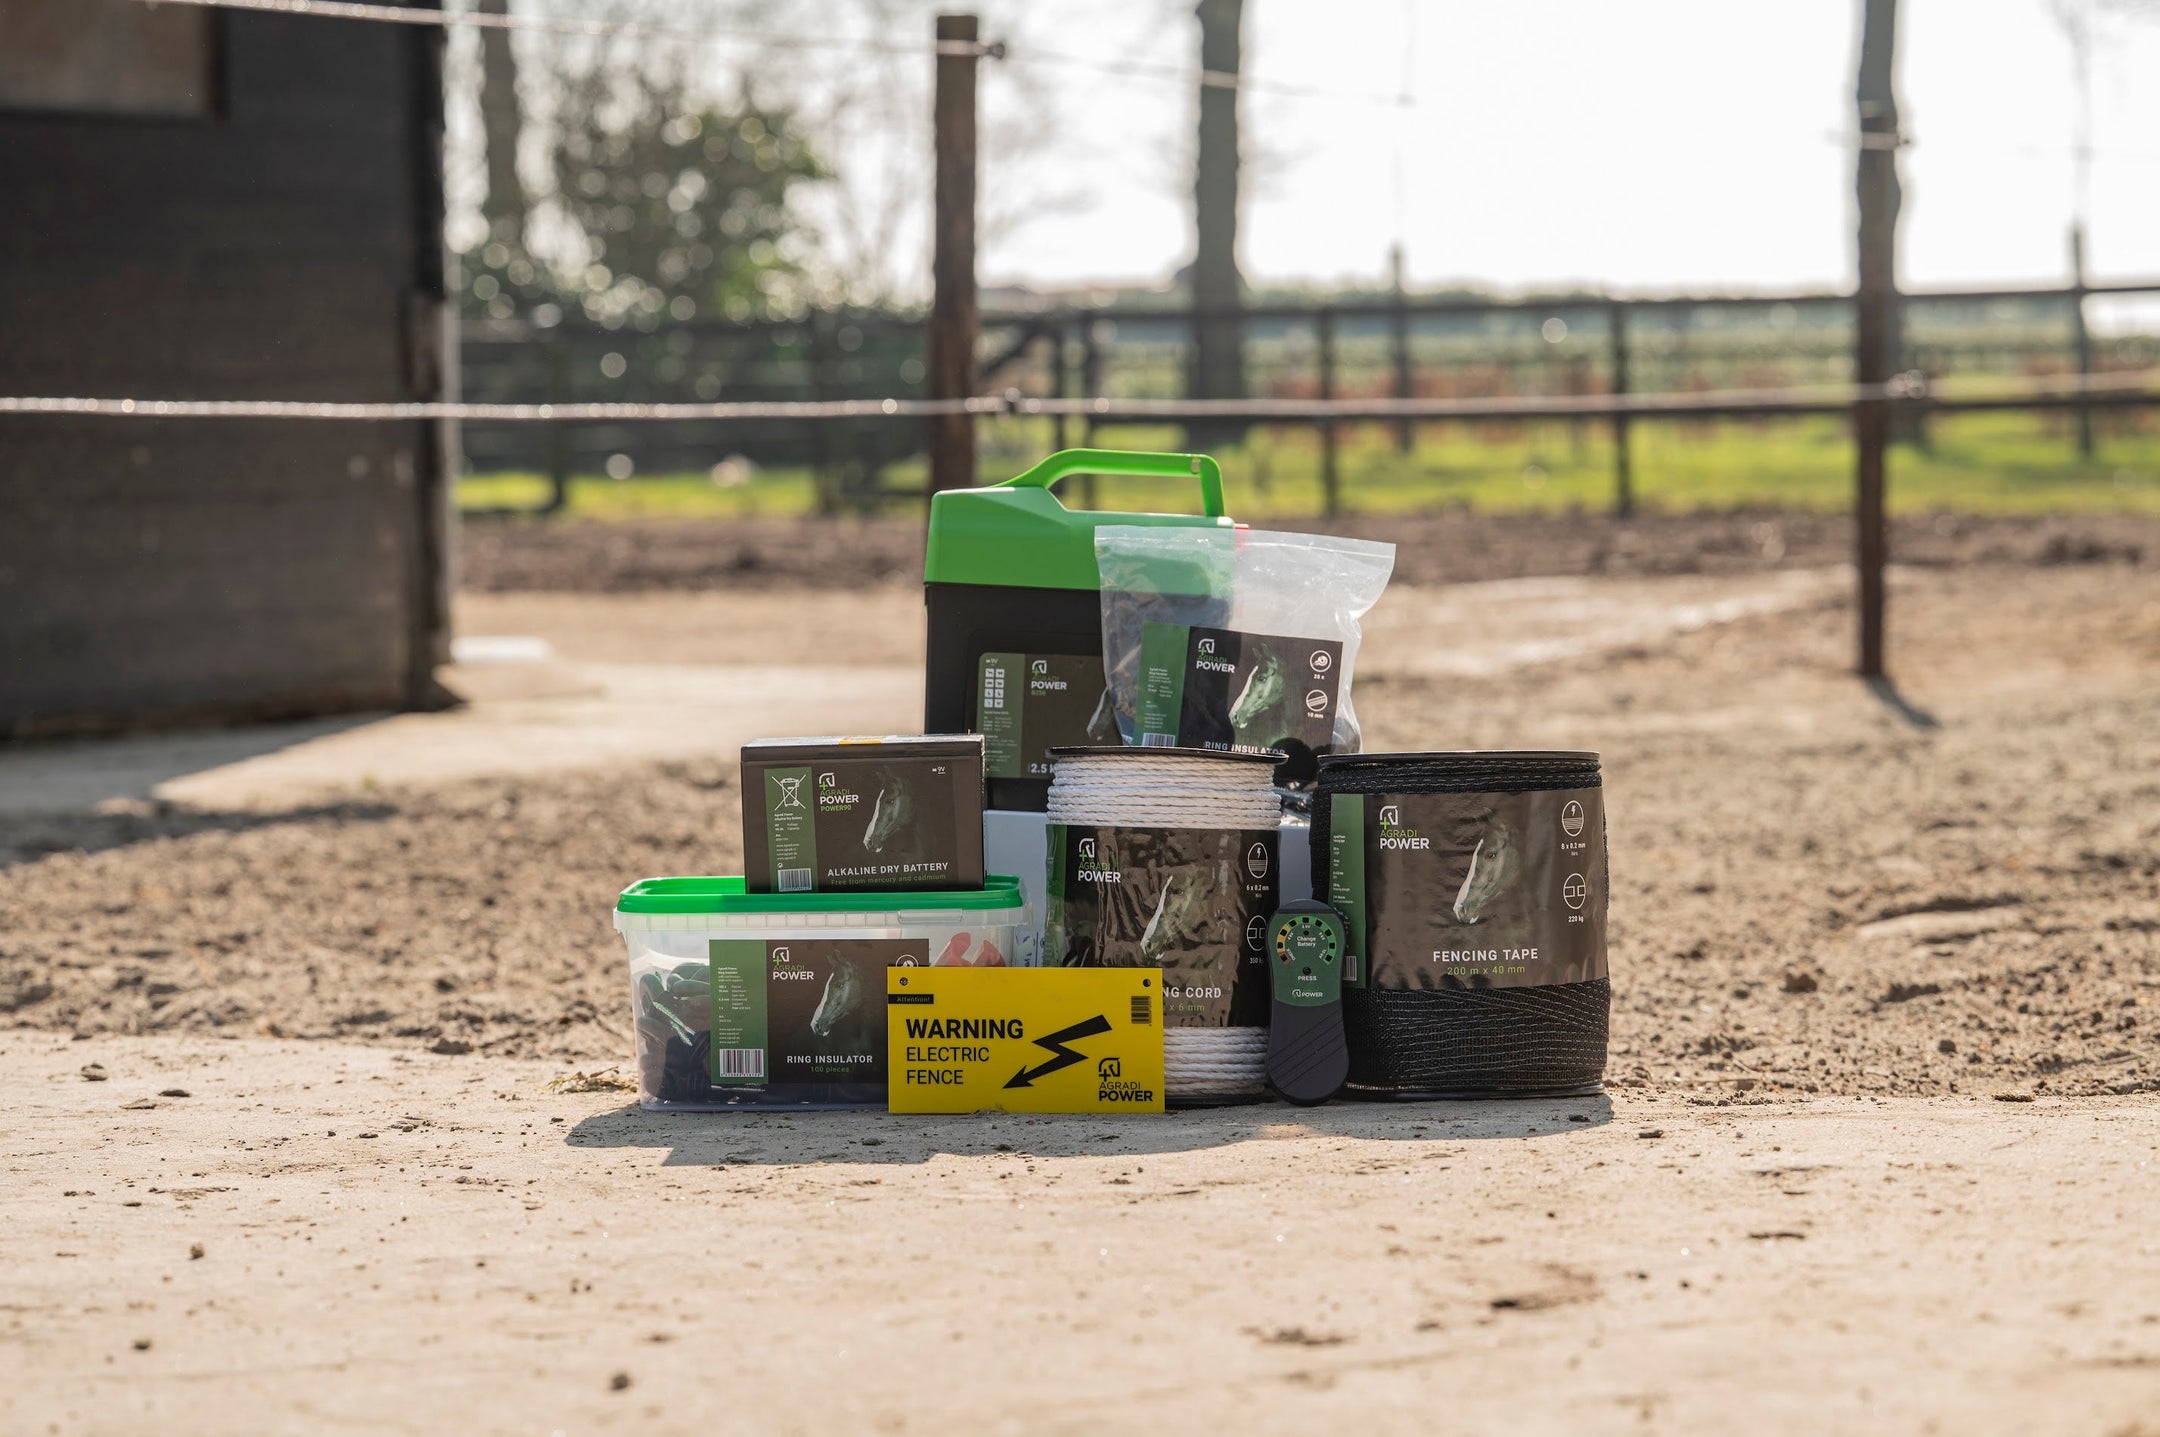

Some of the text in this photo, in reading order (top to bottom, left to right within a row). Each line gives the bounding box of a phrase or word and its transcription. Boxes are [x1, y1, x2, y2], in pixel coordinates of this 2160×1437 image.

[1196, 661, 1235, 673] POWER
[1031, 681, 1067, 690] POWER
[1204, 741, 1228, 751] RING
[1030, 763, 1048, 774] 2.5
[820, 795, 859, 805] POWER
[821, 804, 852, 812] POWER90
[1380, 829, 1418, 837] AGRADI
[1380, 838, 1430, 849] POWER
[827, 862, 949, 877] ALKALINE DRY BATTERY
[1078, 862, 1111, 870] AGRADI
[849, 877, 866, 885] from
[867, 877, 897, 885] mercury
[914, 872, 946, 882] cadmium
[1078, 870, 1121, 883] POWER
[1433, 948, 1538, 962] FENCING TAPE
[1447, 967, 1466, 975] 200
[1492, 965, 1504, 974] 40
[773, 971, 814, 980] POWER
[1186, 987, 1222, 998] CORD
[1178, 1003, 1184, 1011] 6
[1188, 1004, 1205, 1012] mm
[906, 1019, 1023, 1039] WARNING
[787, 1055, 873, 1063] RING INSULATOR
[906, 1047, 990, 1062] ELECTRIC
[825, 1066, 850, 1074] pieces
[907, 1070, 964, 1085] FENCE
[1099, 1081, 1141, 1090] AGRADI
[1098, 1091, 1153, 1102] POWER
